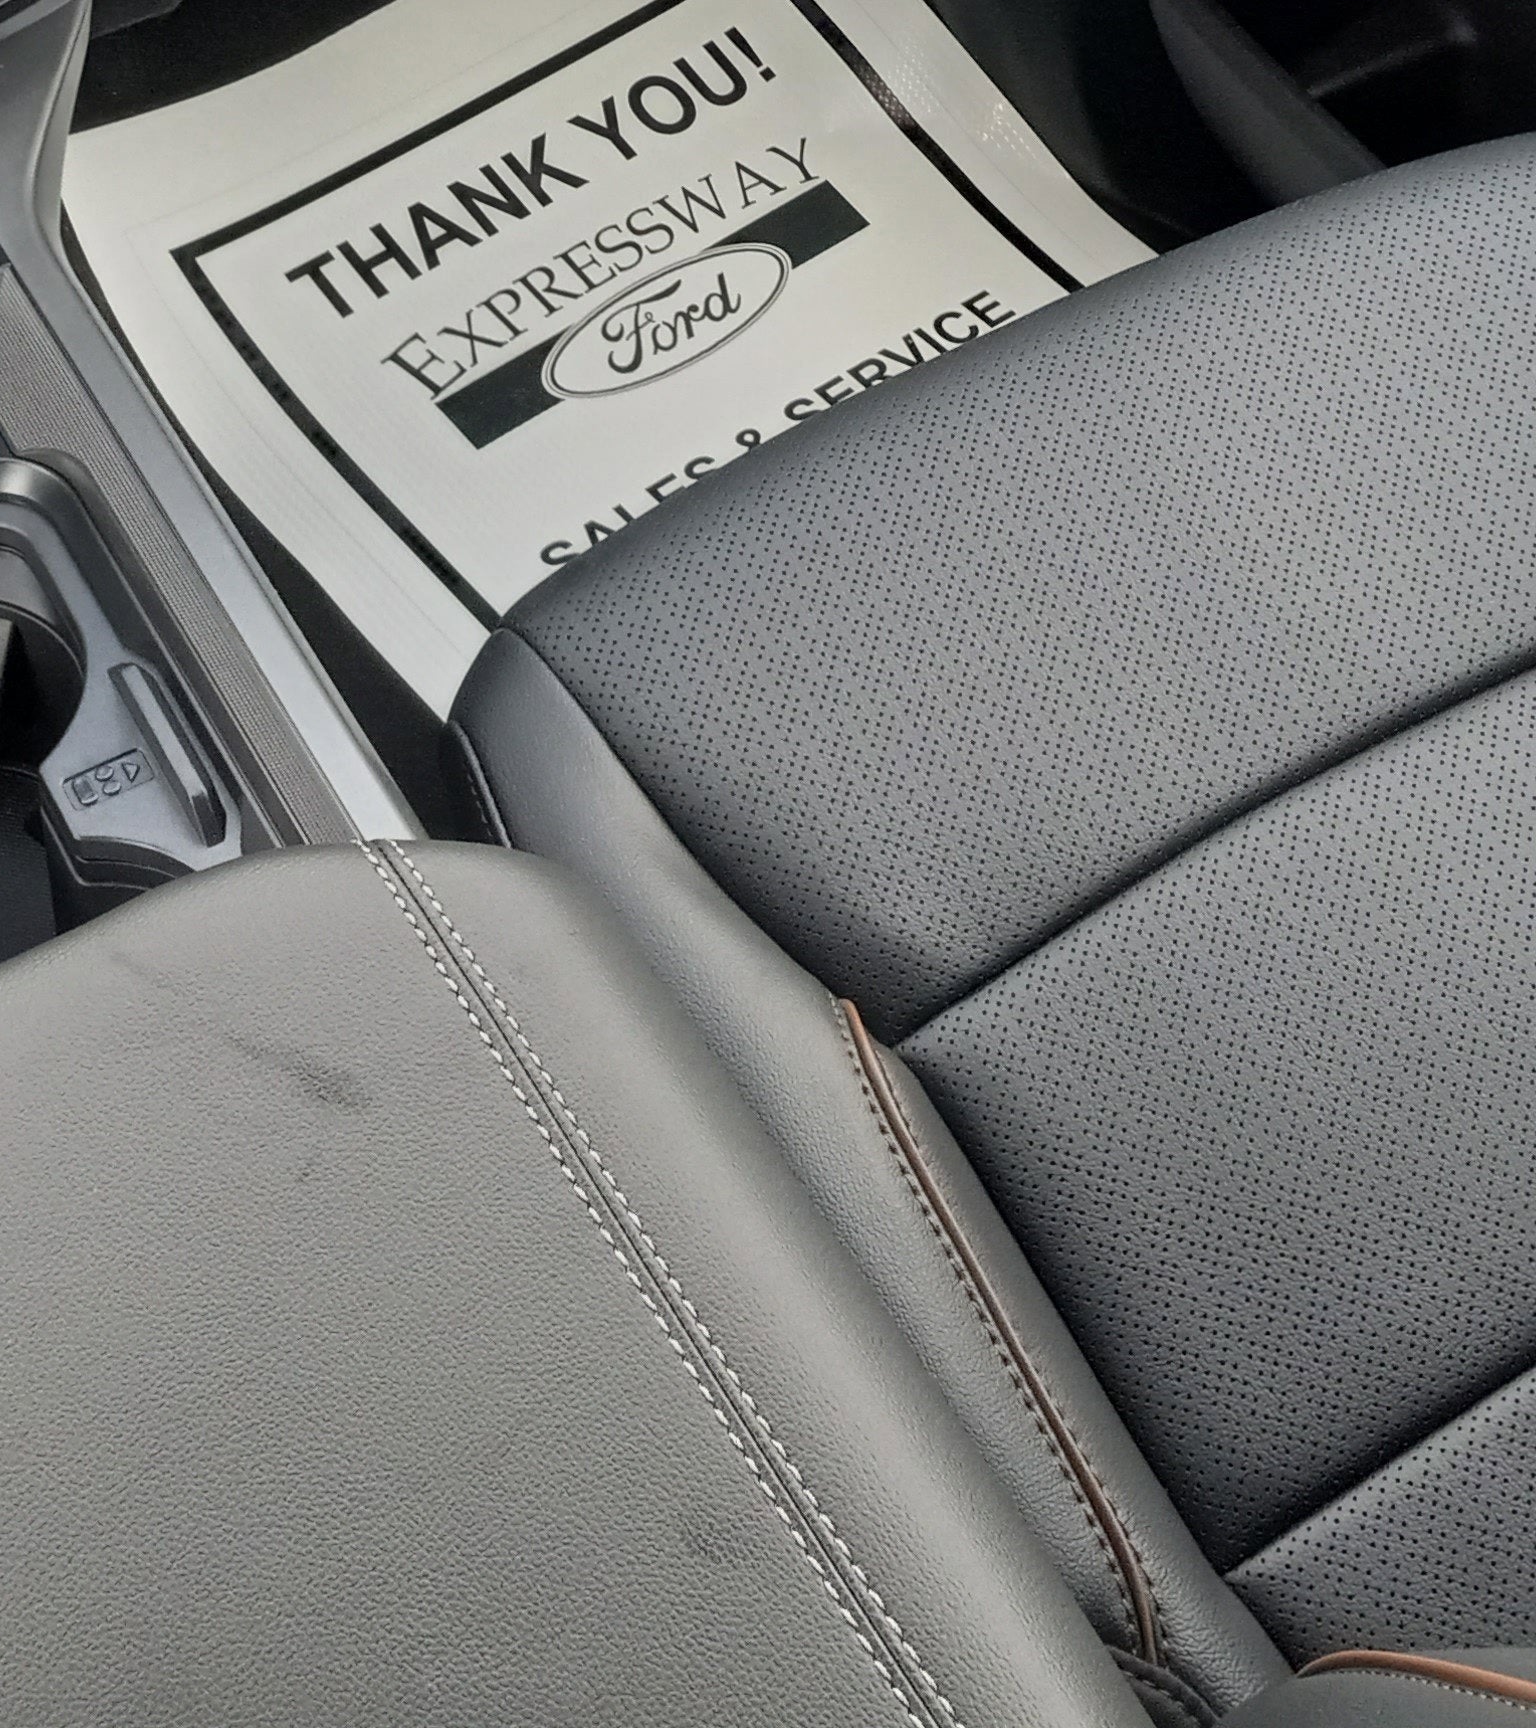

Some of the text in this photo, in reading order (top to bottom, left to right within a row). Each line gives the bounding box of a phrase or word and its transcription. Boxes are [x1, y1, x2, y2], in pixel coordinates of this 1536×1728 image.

[285, 27, 777, 319] THANK YOU!
[382, 137, 822, 398] EXPRESSWAY
[601, 272, 743, 375] Ford
